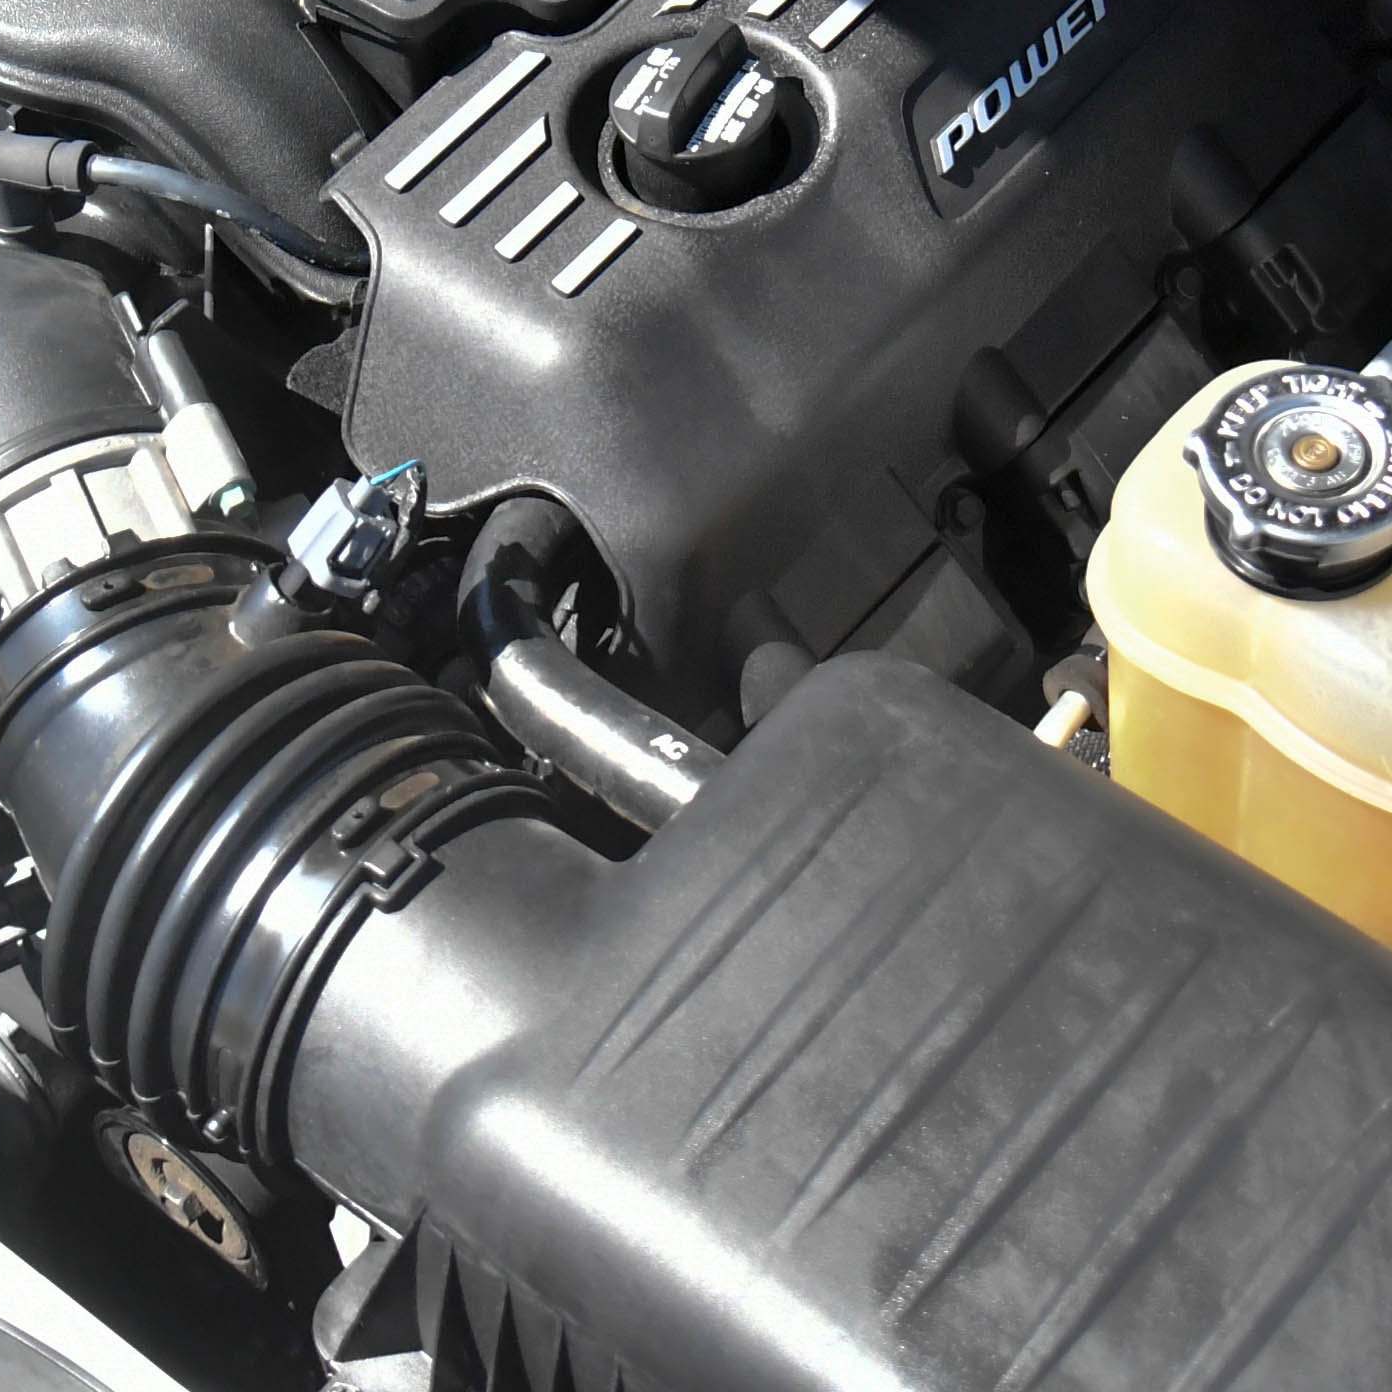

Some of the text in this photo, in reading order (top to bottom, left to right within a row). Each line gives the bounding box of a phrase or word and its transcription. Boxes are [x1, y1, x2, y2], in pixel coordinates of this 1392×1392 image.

[1217, 384, 1270, 437] KEEP
[1229, 473, 1269, 505] DO
[1266, 499, 1323, 527] NOT
[649, 733, 689, 760] AC
